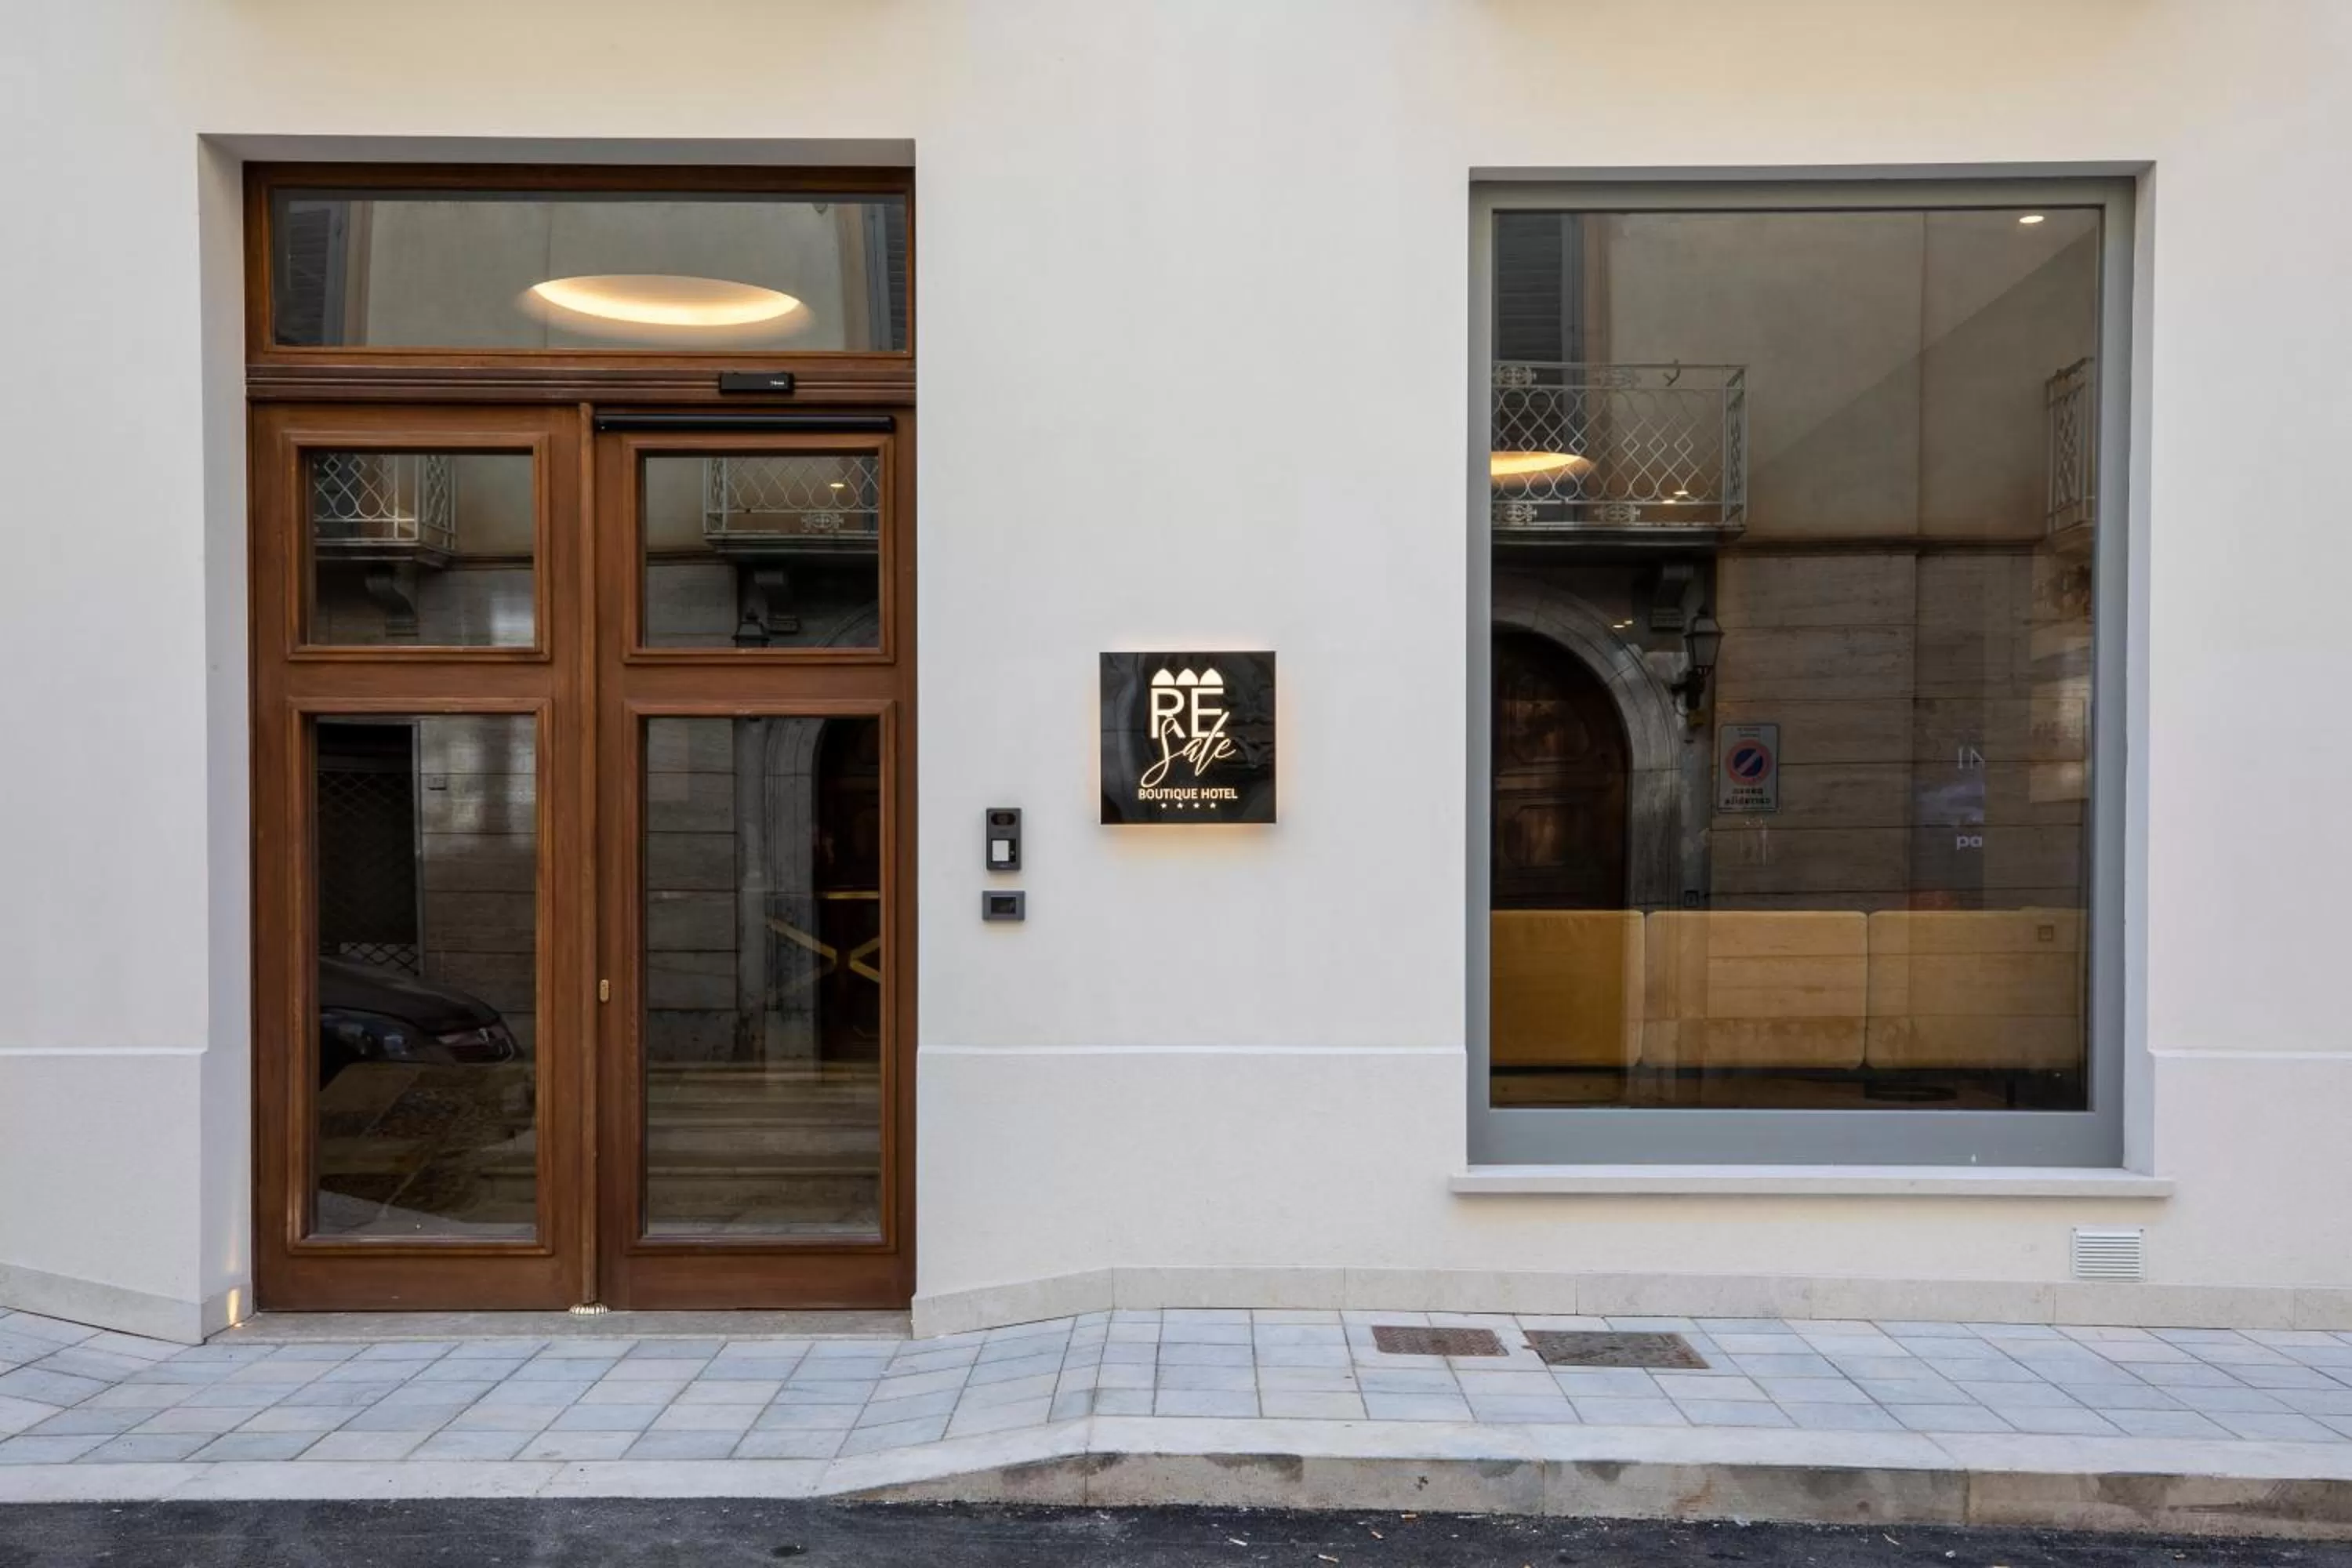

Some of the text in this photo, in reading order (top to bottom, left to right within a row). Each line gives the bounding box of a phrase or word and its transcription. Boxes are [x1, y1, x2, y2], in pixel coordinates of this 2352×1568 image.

[1151, 688, 1225, 738] RE
[1138, 788, 1238, 800] BOUTIQUE HOTEL
